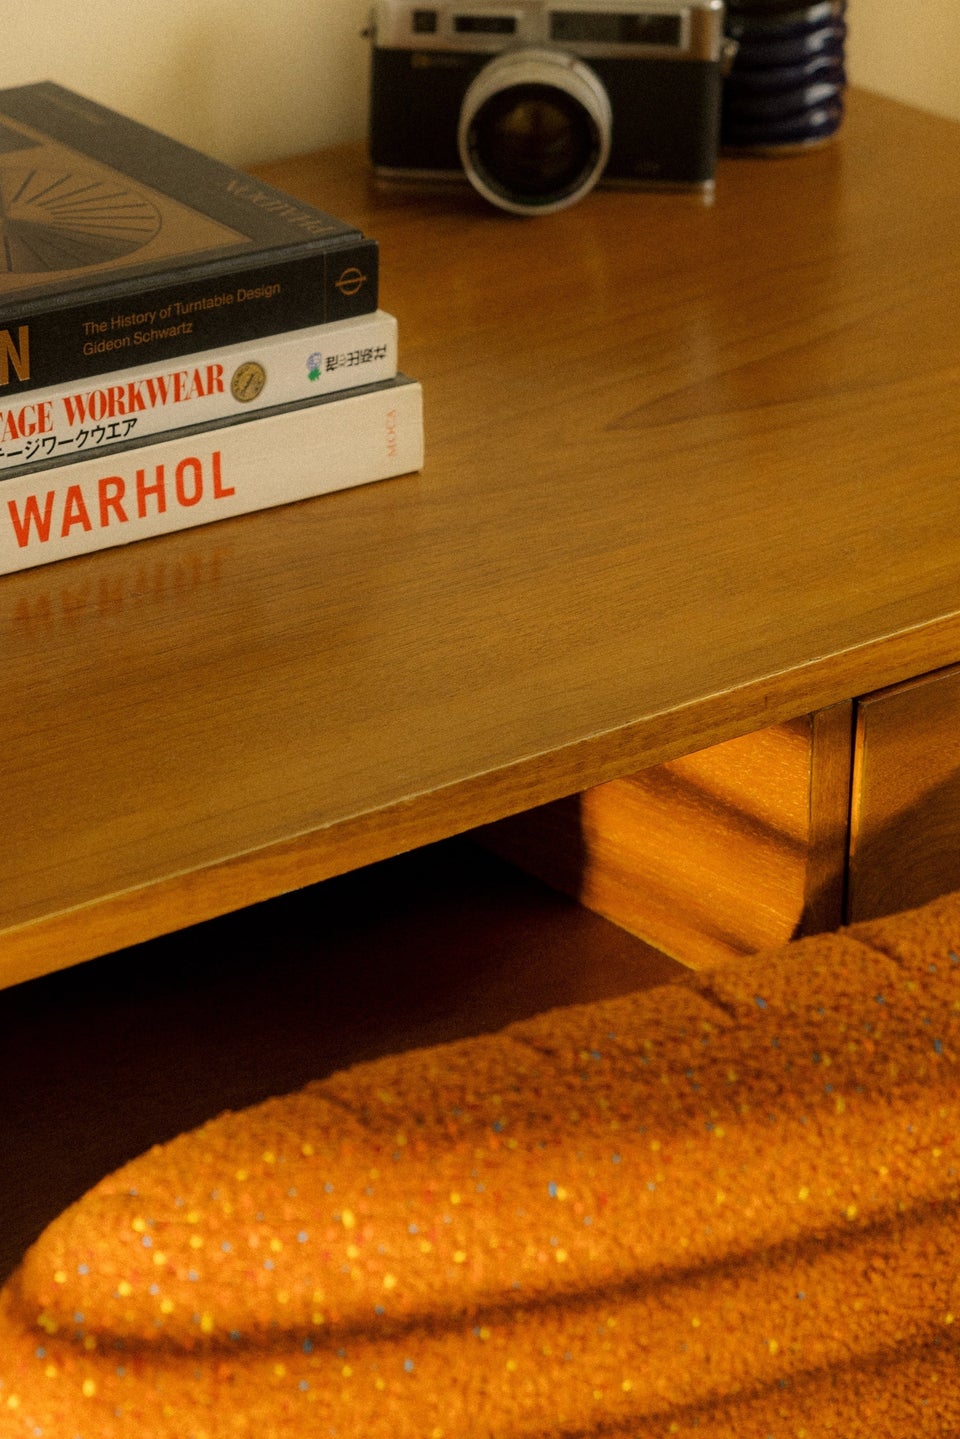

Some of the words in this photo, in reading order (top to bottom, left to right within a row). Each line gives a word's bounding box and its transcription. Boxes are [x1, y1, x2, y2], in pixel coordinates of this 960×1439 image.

[82, 321, 107, 337] The
[111, 309, 156, 329] History
[159, 304, 173, 320] of
[174, 293, 233, 316] Turntable
[237, 283, 281, 303] Design
[83, 336, 131, 356] Gideon
[134, 322, 193, 345] Schwartz
[62, 363, 225, 427] WORKWEAR
[7, 450, 236, 548] WARHOL
